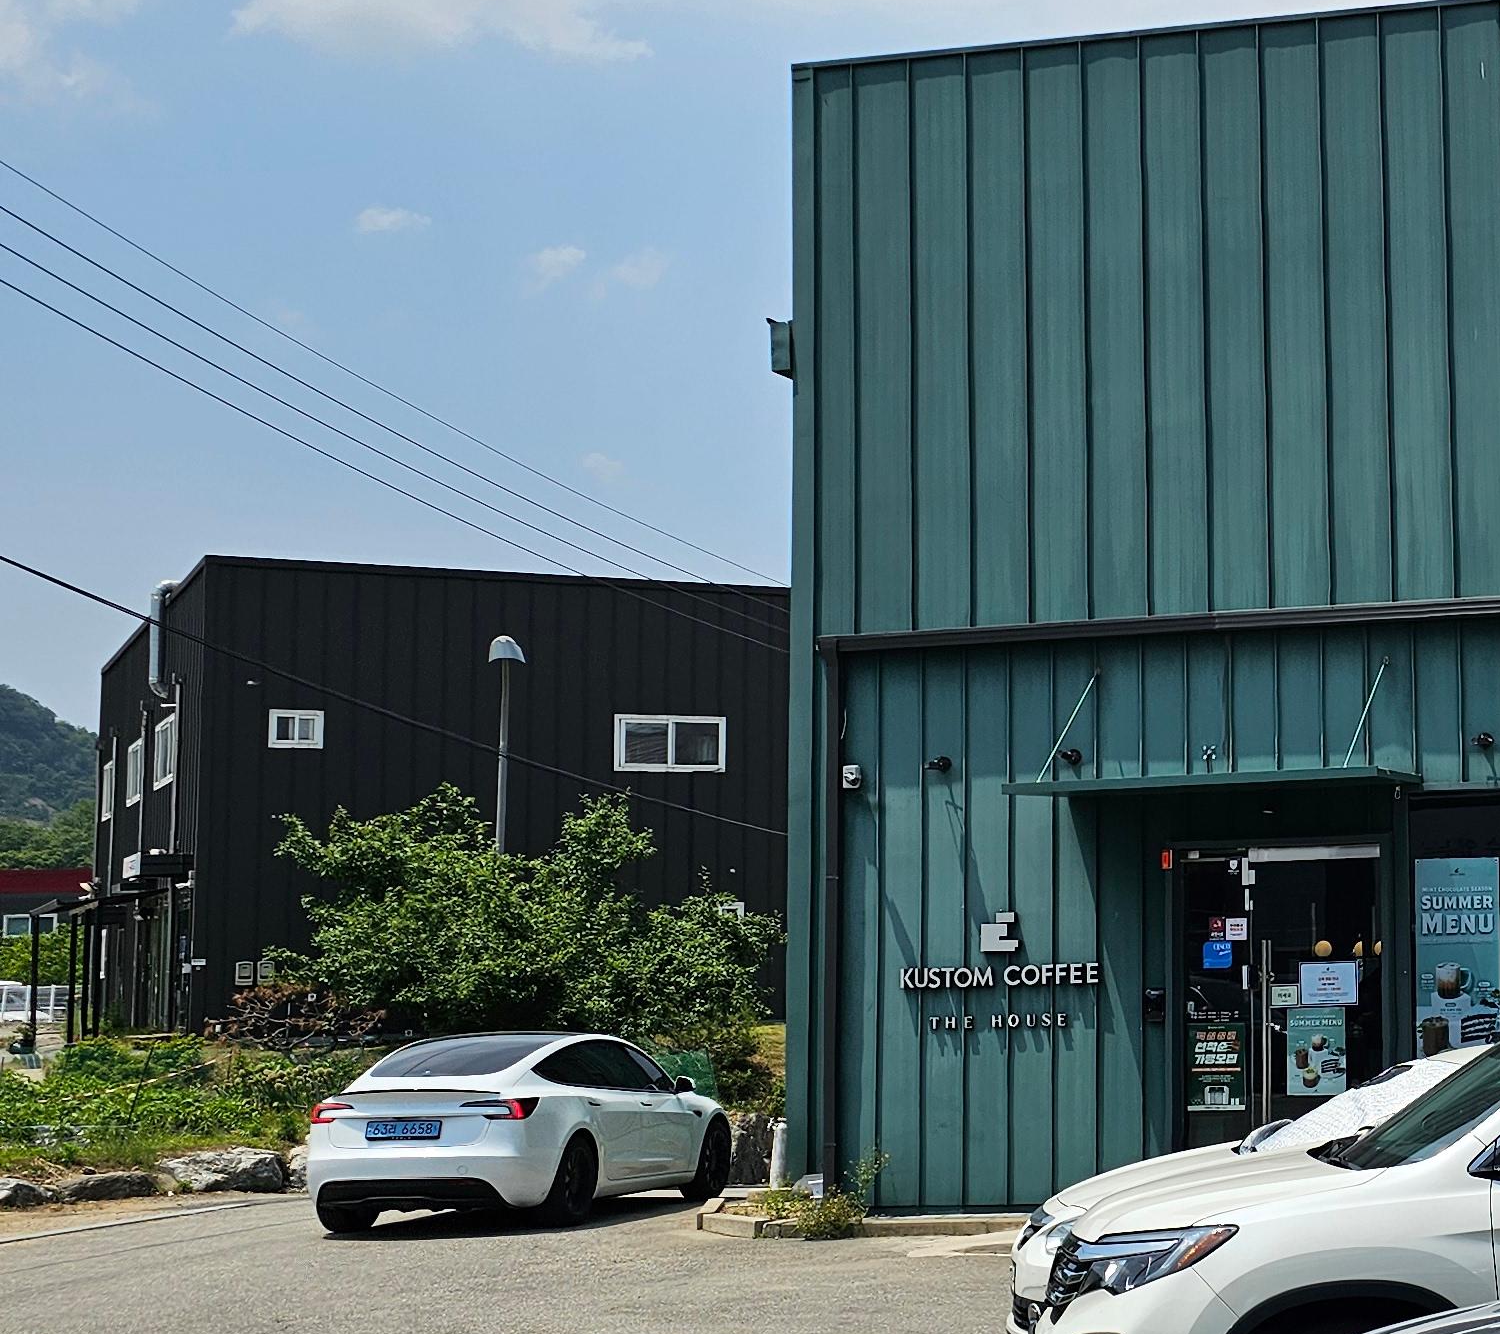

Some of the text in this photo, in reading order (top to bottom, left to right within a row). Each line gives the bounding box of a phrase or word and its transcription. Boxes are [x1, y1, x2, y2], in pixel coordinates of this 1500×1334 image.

[1421, 895, 1494, 910] SUMMER
[1421, 912, 1495, 935] MENU
[900, 962, 1099, 989] KUSTOM COFFEE
[929, 1012, 1068, 1030] THE HOUSE
[1289, 1018, 1343, 1027] SUMMER MENU
